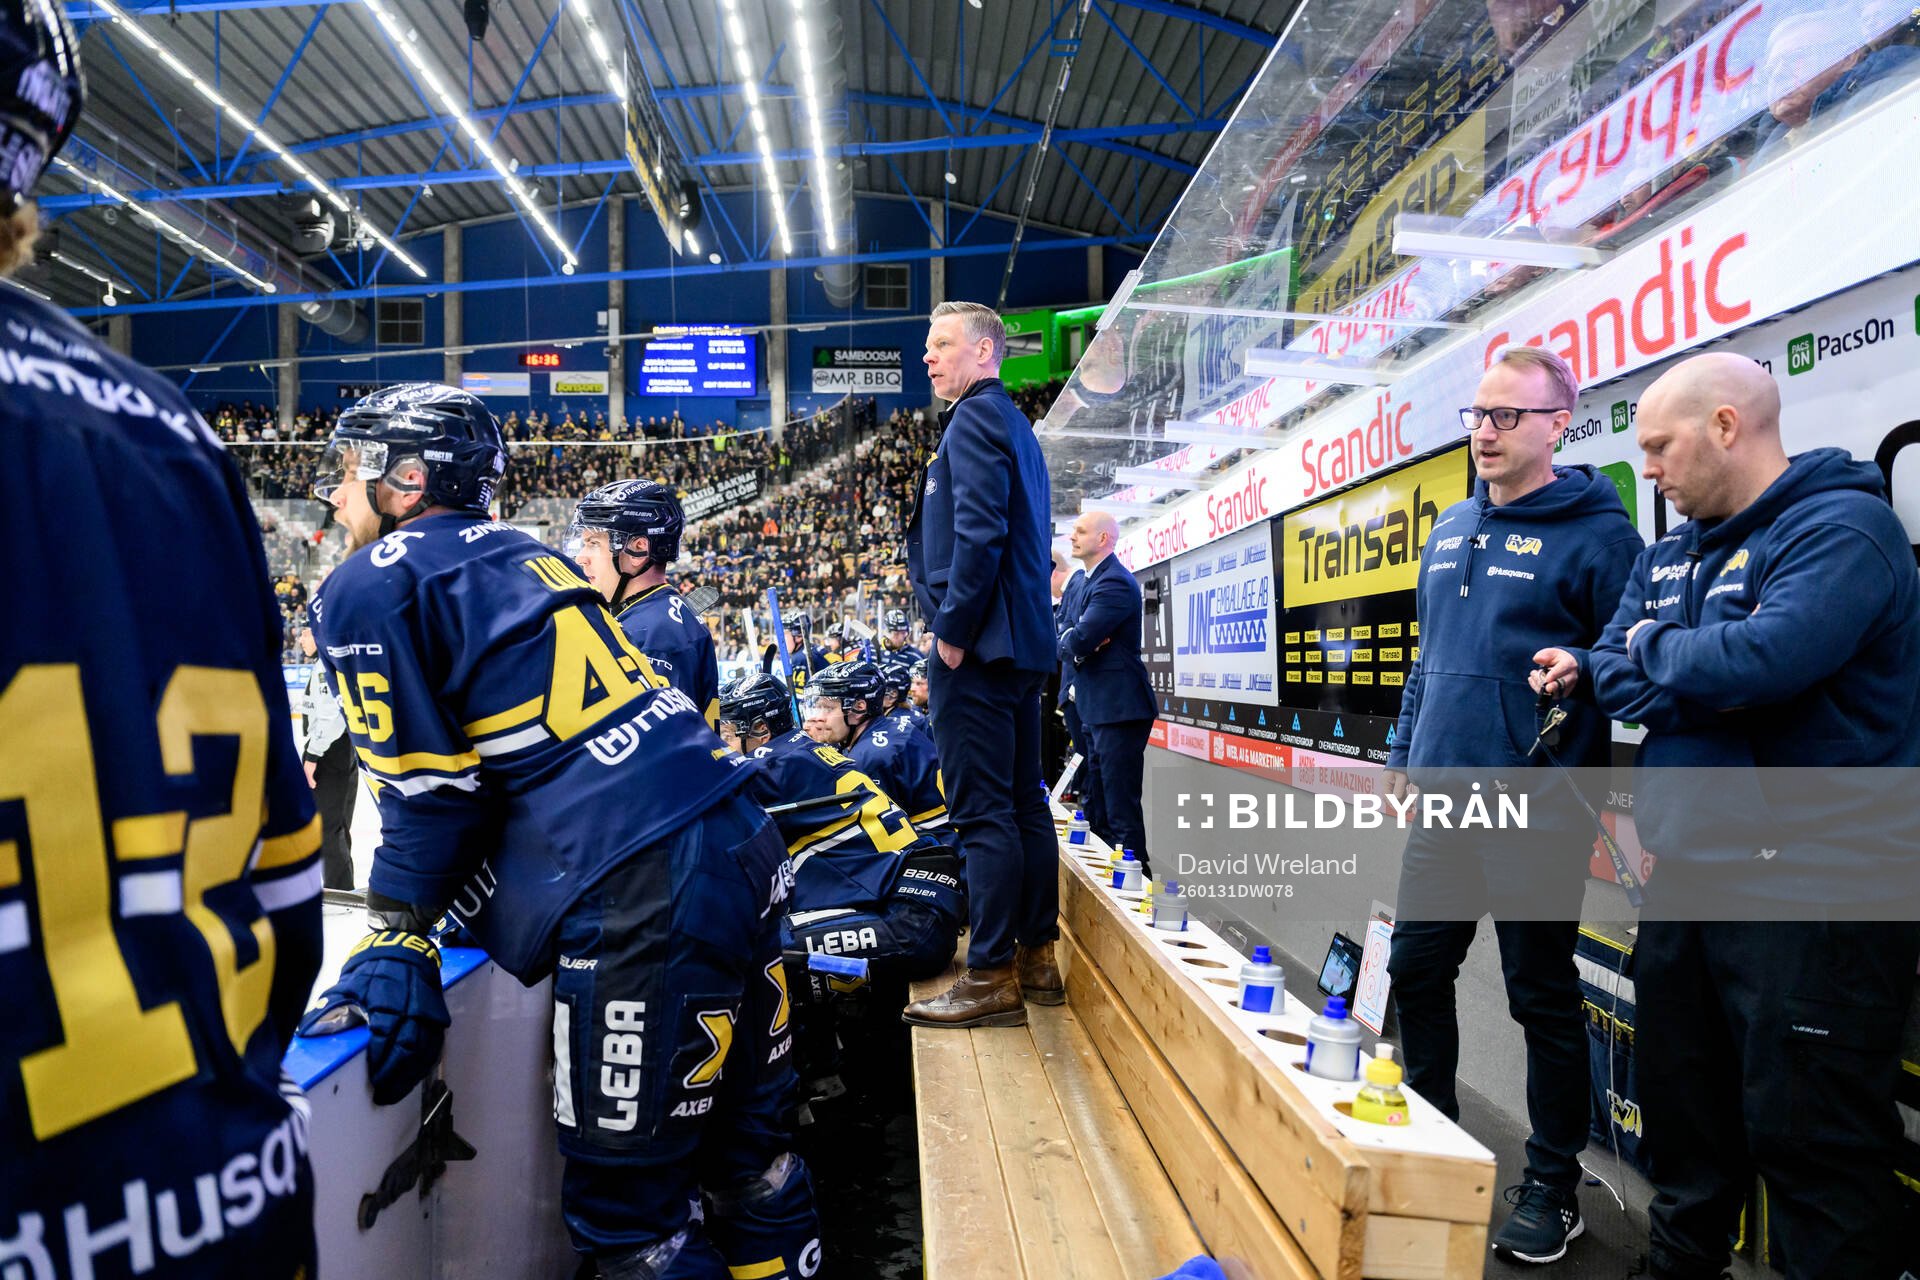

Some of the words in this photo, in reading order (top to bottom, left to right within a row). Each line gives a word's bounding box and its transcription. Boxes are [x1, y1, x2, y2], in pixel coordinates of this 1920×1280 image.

[1817, 317, 1895, 362] PacsOn
[834, 350, 901, 361] SAMBOOSAK
[1791, 352, 1811, 369] ON
[864, 371, 902, 387] BBQ
[1563, 416, 1602, 447] PacsOn
[1301, 391, 1415, 497] Scandic
[1207, 467, 1269, 539] Scandic
[1147, 510, 1189, 563] Scandic
[1299, 484, 1438, 584] Transab
[1257, 575, 1269, 608] AB
[1177, 589, 1216, 656] JUNE
[1353, 628, 1369, 637] Transab
[1381, 626, 1399, 636] Transab
[1354, 652, 1370, 660] Transab
[1382, 651, 1400, 660] Transab
[1355, 674, 1371, 682] Transab
[1383, 675, 1401, 683] Transab
[336, 670, 394, 743] 46
[1318, 739, 1361, 756] ONEPARTNERGROUP
[1250, 749, 1286, 773] MARKETING.
[1320, 766, 1329, 785] BE
[1330, 769, 1375, 795] AMAZING!
[903, 868, 958, 888] BAUER
[898, 886, 937, 898] BAUER
[805, 927, 878, 955] LEBA
[597, 1000, 646, 1132] LEBA
